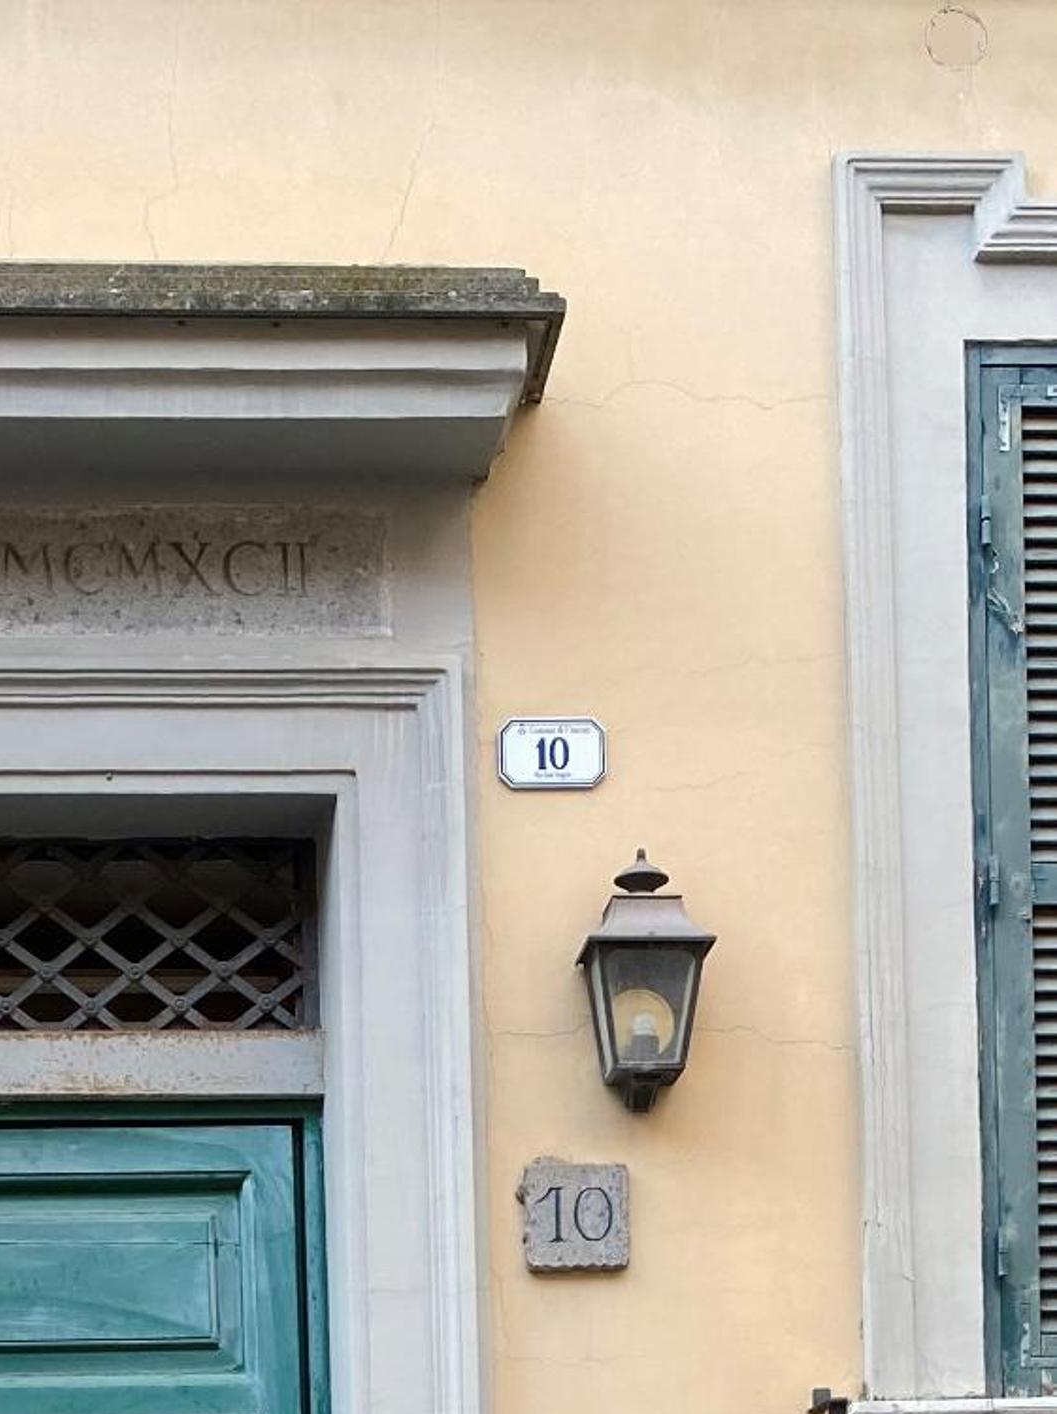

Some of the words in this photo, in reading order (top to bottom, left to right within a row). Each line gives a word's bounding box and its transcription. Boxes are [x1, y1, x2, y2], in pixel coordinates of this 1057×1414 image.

[0, 539, 310, 598] MCMXCII
[536, 736, 569, 770] 10
[534, 1186, 613, 1243] 10
